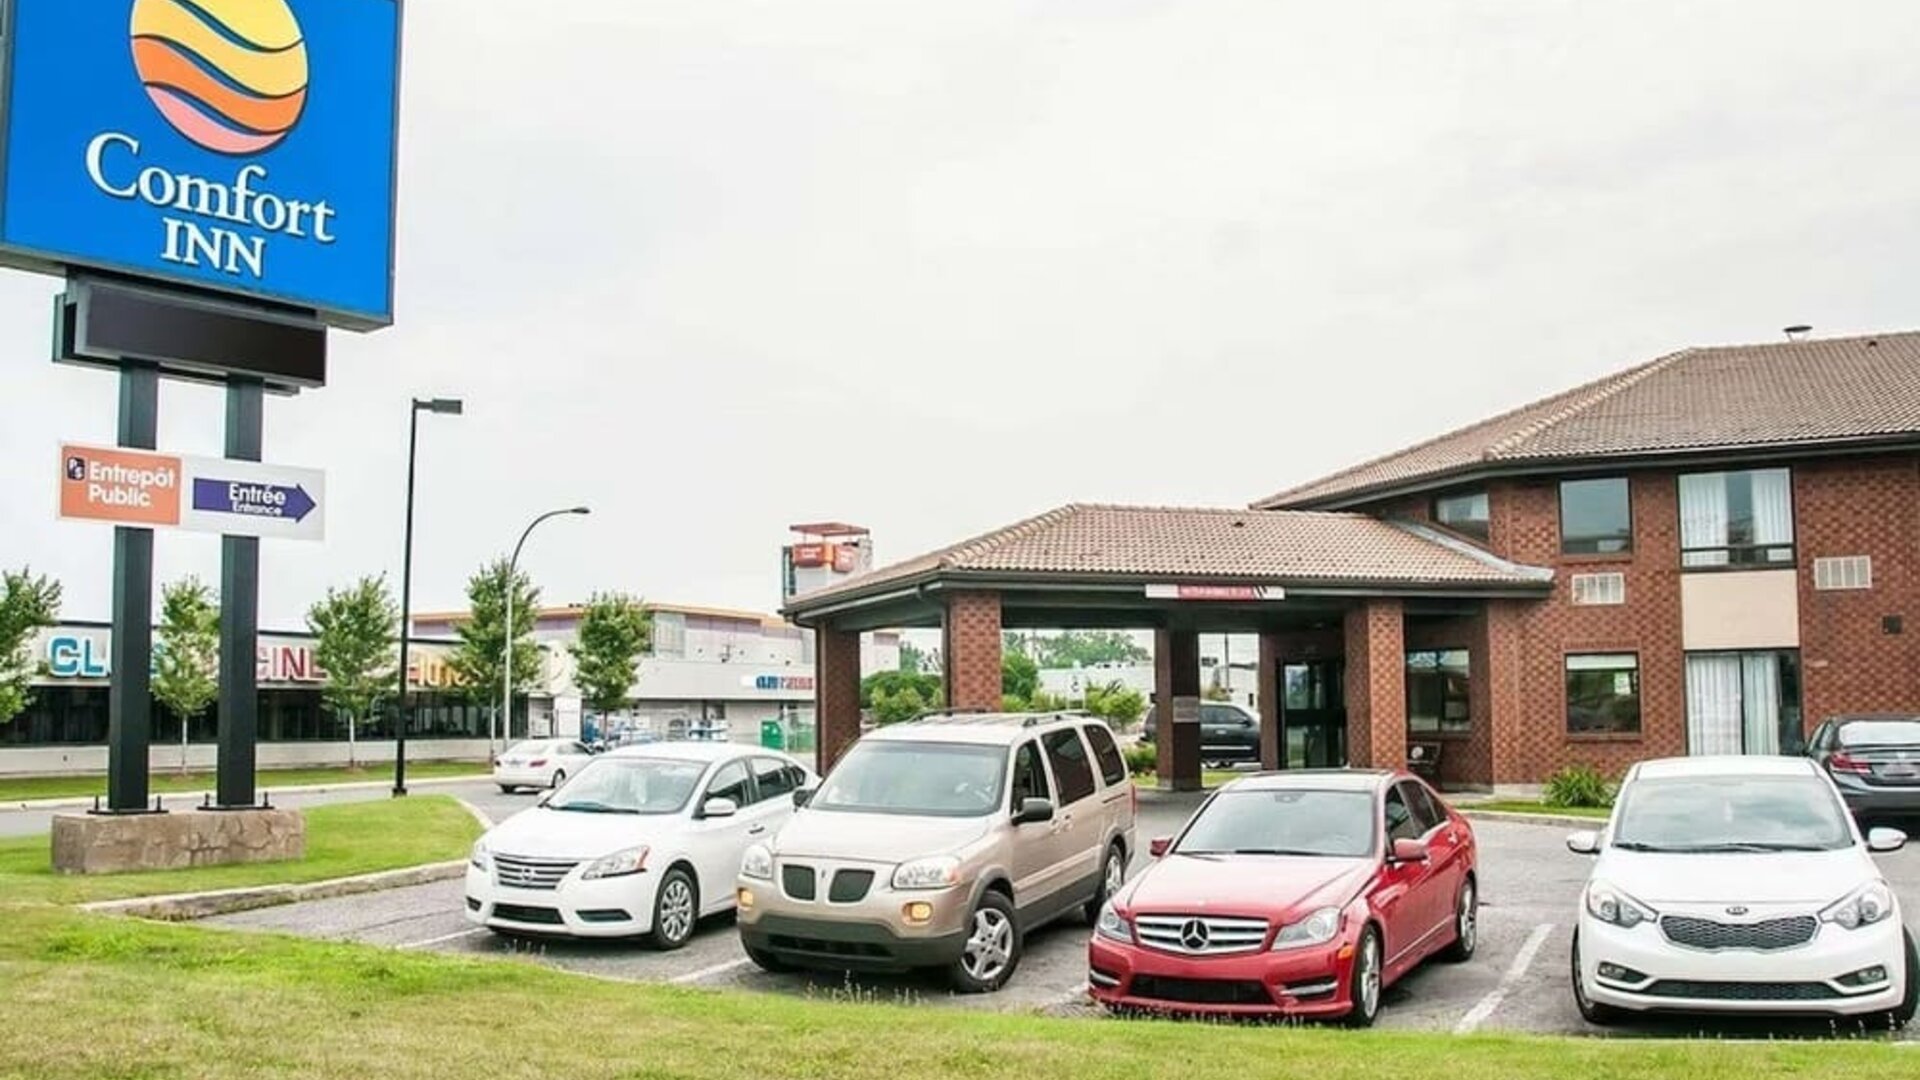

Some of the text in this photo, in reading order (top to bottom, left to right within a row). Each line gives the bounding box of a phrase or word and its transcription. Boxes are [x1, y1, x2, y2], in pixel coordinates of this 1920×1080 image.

[85, 132, 335, 243] Comfort
[161, 217, 265, 278] INN
[88, 461, 175, 489] Entrepôt
[87, 483, 152, 508] Public
[229, 483, 286, 506] Entrée
